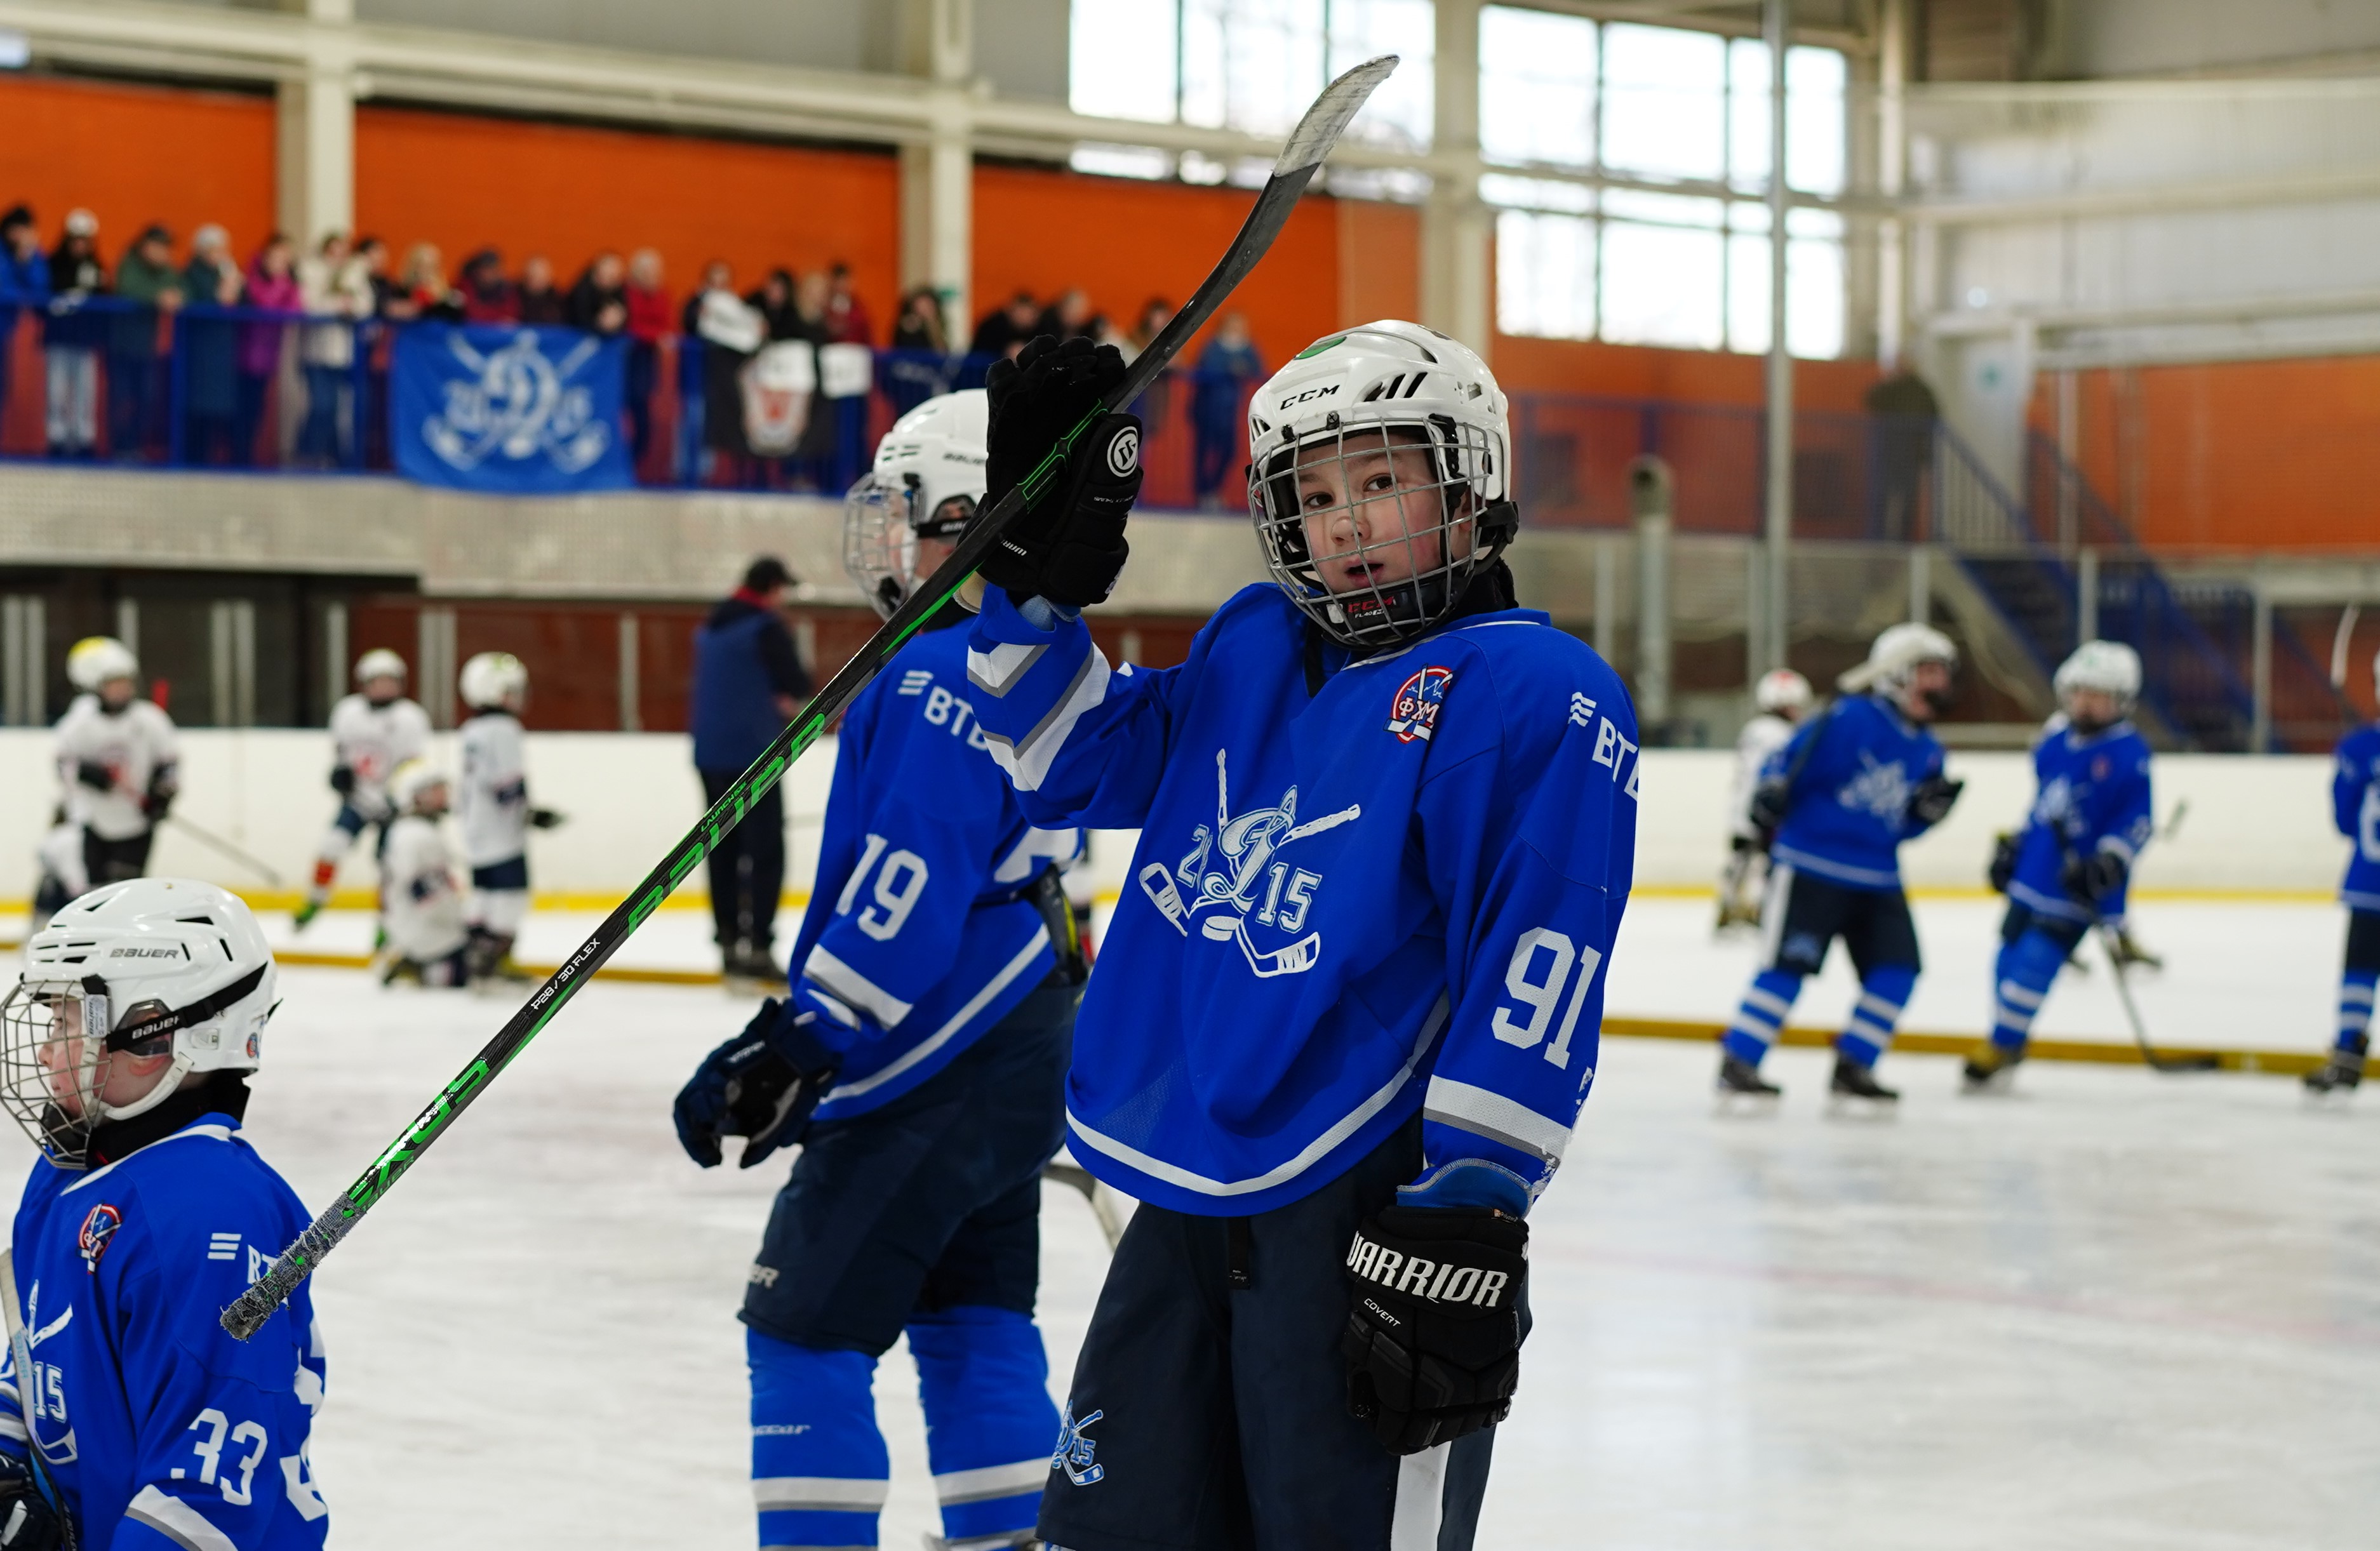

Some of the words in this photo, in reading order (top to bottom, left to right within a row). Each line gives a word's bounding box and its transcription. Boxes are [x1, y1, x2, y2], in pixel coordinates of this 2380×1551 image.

[1280, 385, 1340, 410] CCM
[1347, 596, 1394, 613] CCM
[836, 834, 928, 940] 19
[110, 949, 178, 959] BAUER
[530, 985, 554, 1009] P28
[572, 938, 600, 967] FLEX
[1491, 926, 1601, 1069] 91
[348, 1057, 491, 1207] EXUS
[361, 1155, 415, 1211] AUER
[1364, 1298, 1401, 1326] COVERT
[32, 1361, 67, 1423] 15
[170, 1408, 268, 1506] 33
[1070, 1436, 1096, 1467] 15
